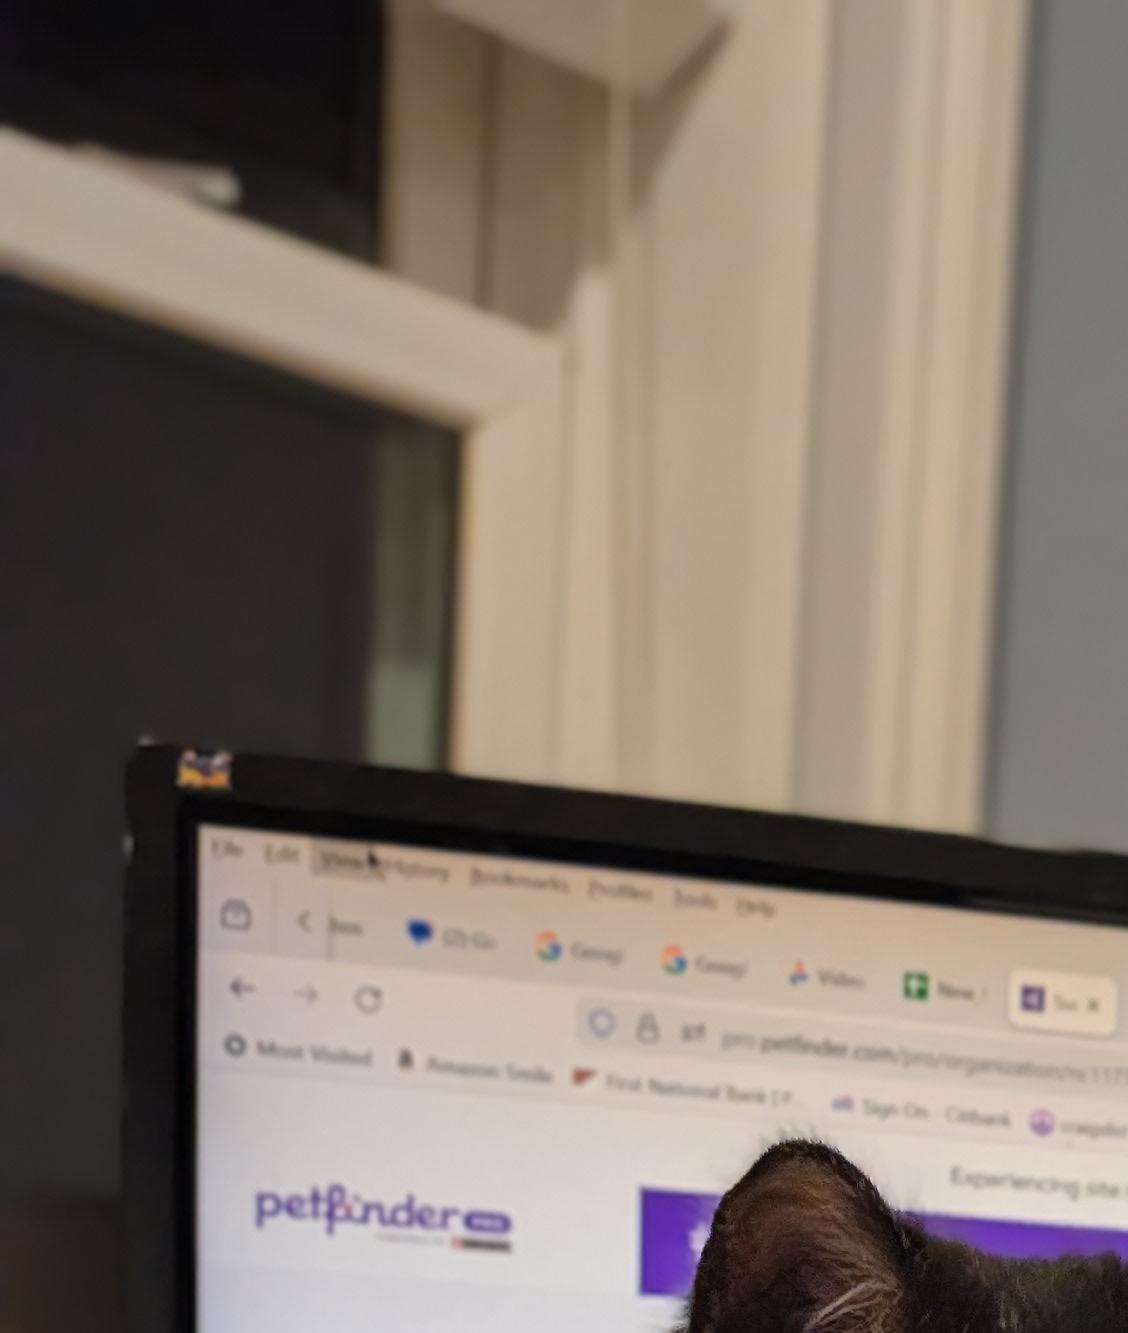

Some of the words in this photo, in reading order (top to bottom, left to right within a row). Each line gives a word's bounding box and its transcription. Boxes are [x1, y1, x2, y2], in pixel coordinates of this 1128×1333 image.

[265, 844, 300, 864] Edit
[471, 868, 570, 894] Bookmarks
[257, 1040, 304, 1062] Most
[310, 1046, 372, 1068] Visited
[948, 1165, 1081, 1202] Experiencing
[254, 1183, 459, 1236] petfinder
